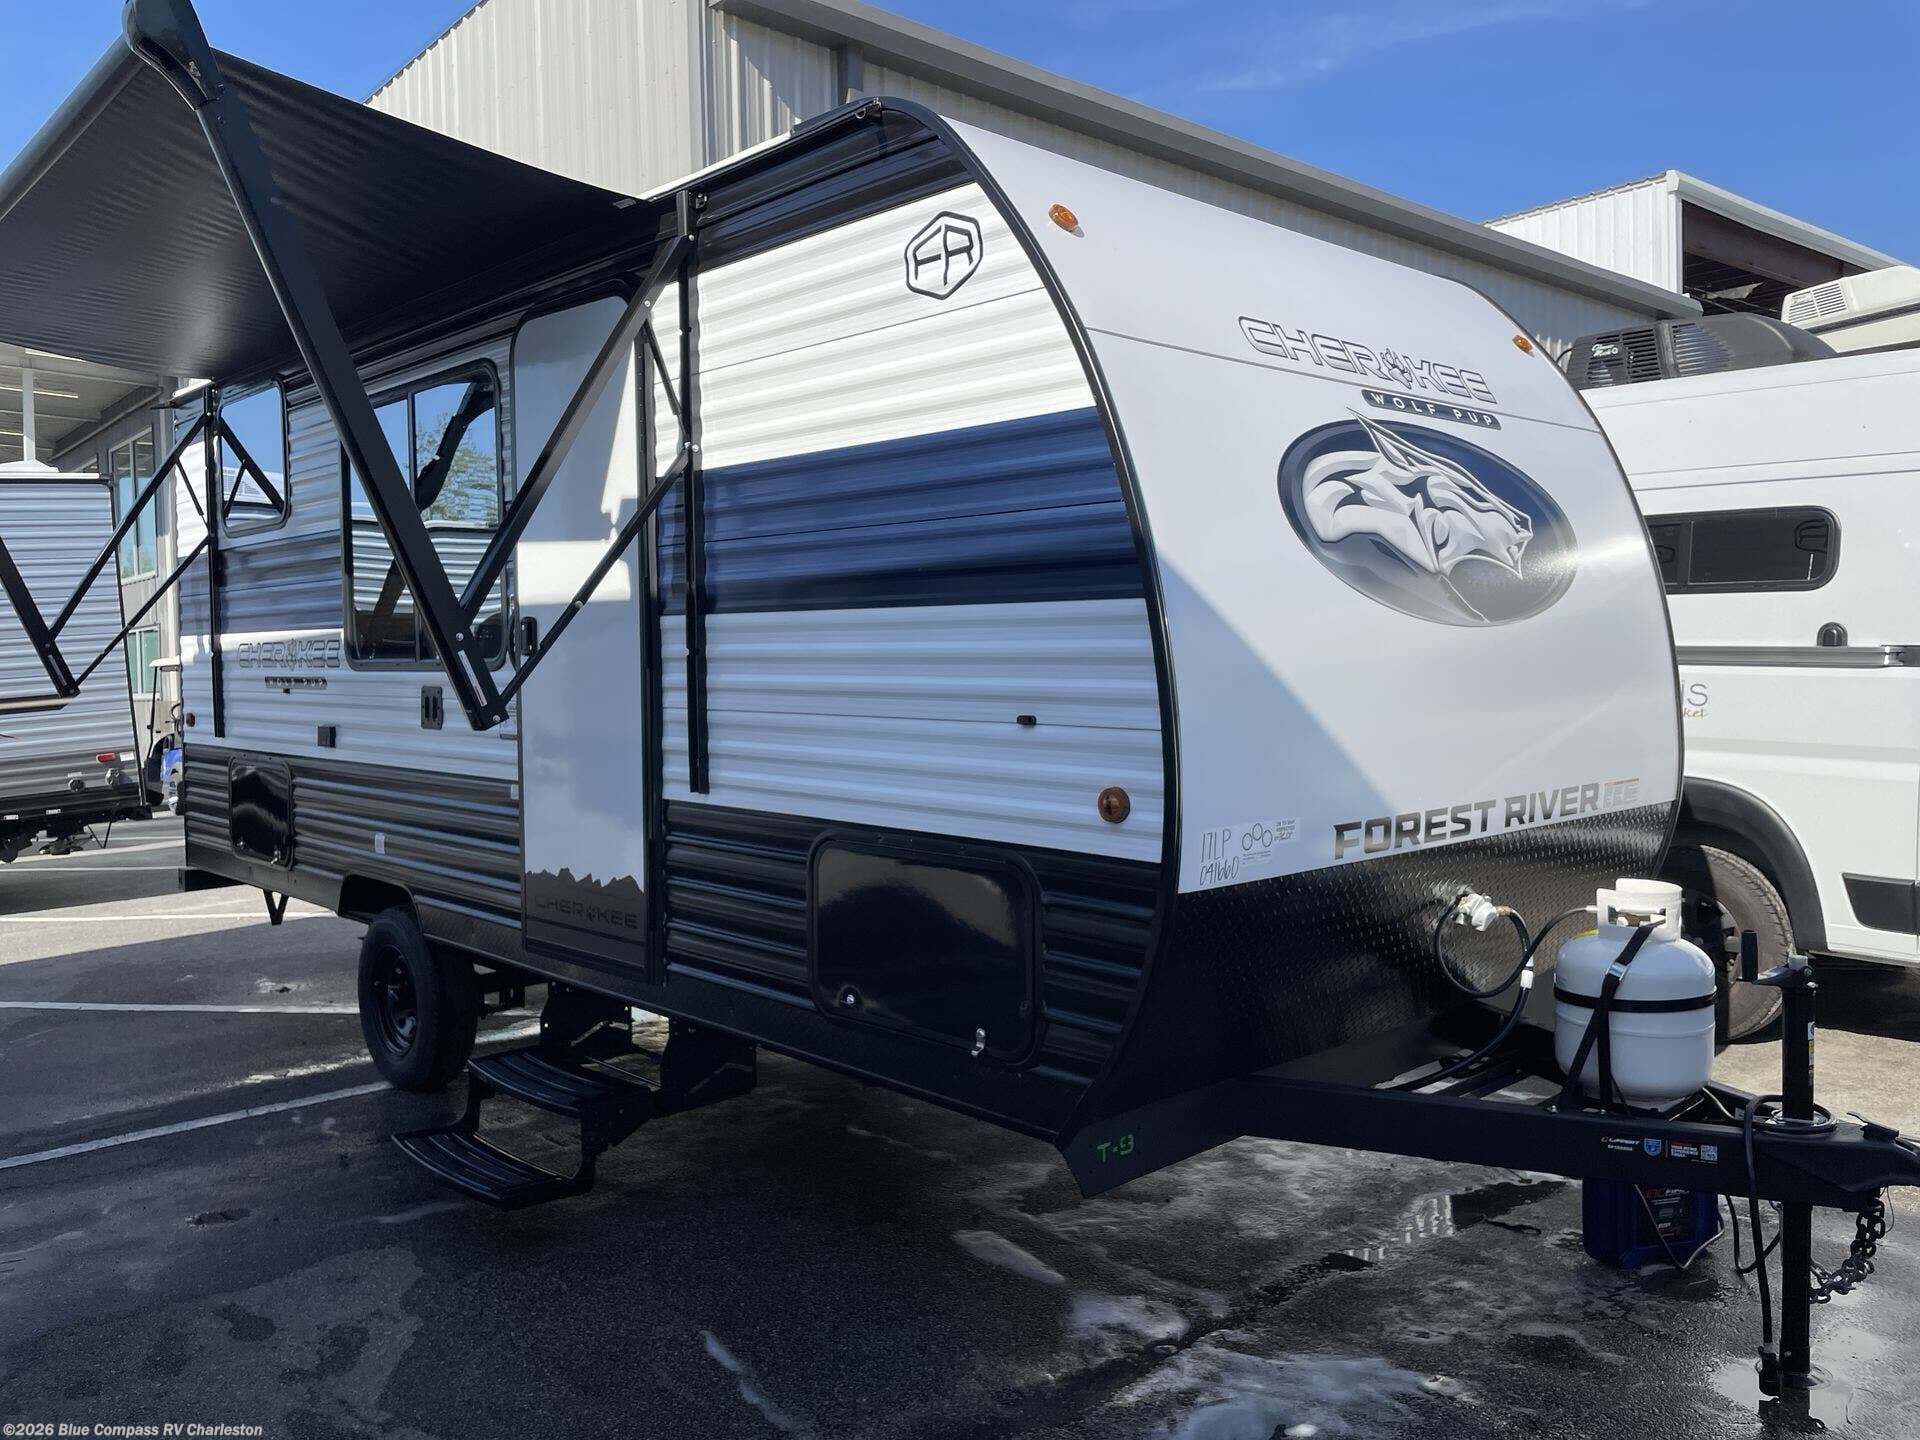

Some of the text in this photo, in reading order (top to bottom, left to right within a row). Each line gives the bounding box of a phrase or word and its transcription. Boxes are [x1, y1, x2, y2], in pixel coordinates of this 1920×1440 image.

[1369, 391, 1493, 428] WOLF PUP
[1333, 799, 1497, 860] FOREST
[1503, 782, 1600, 828] RIVER
[1201, 827, 1233, 864] 17LP
